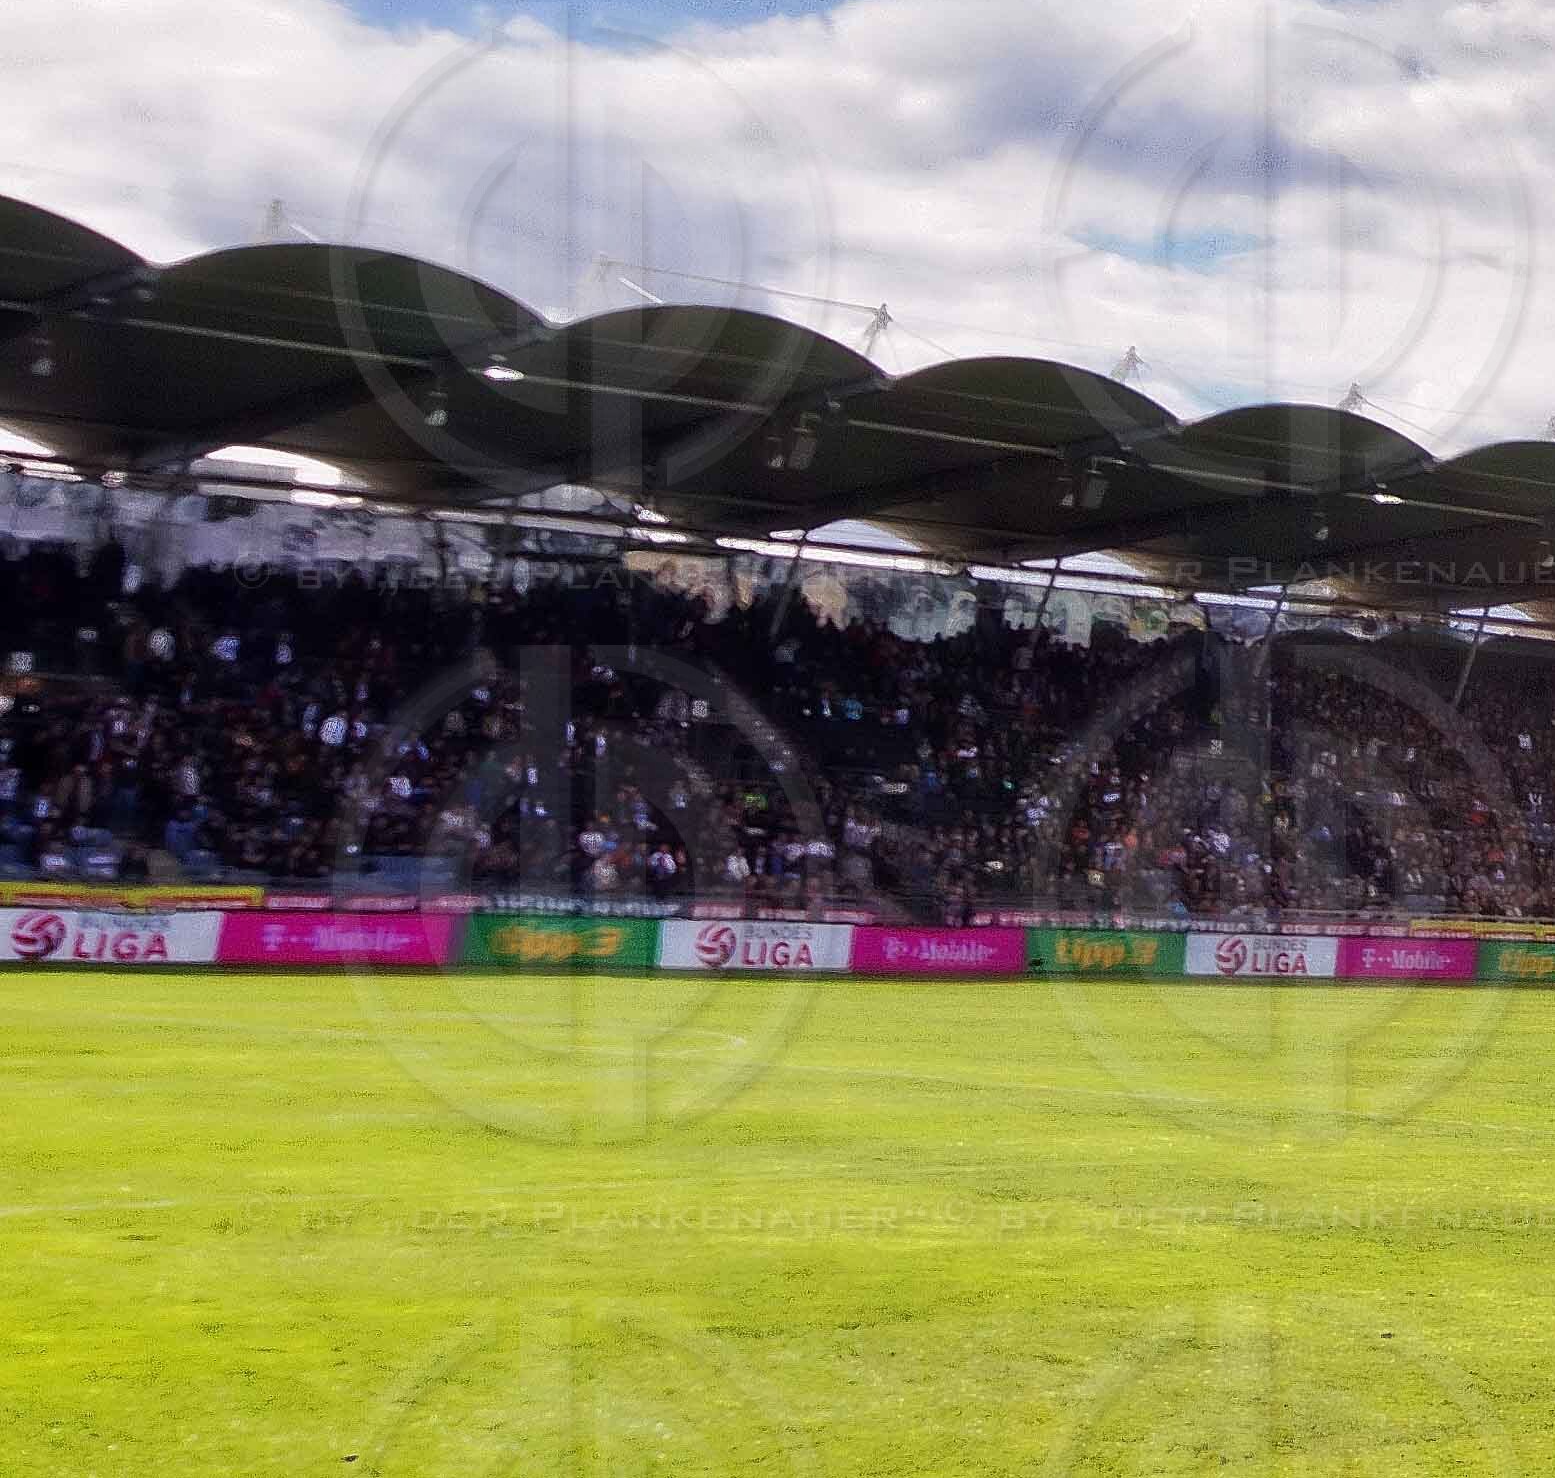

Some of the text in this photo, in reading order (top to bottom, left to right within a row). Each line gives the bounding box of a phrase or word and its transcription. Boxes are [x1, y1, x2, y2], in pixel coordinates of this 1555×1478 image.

[73, 930, 169, 962] LIGA
[742, 941, 813, 967] LIGA
[1250, 951, 1307, 977] LIGA
